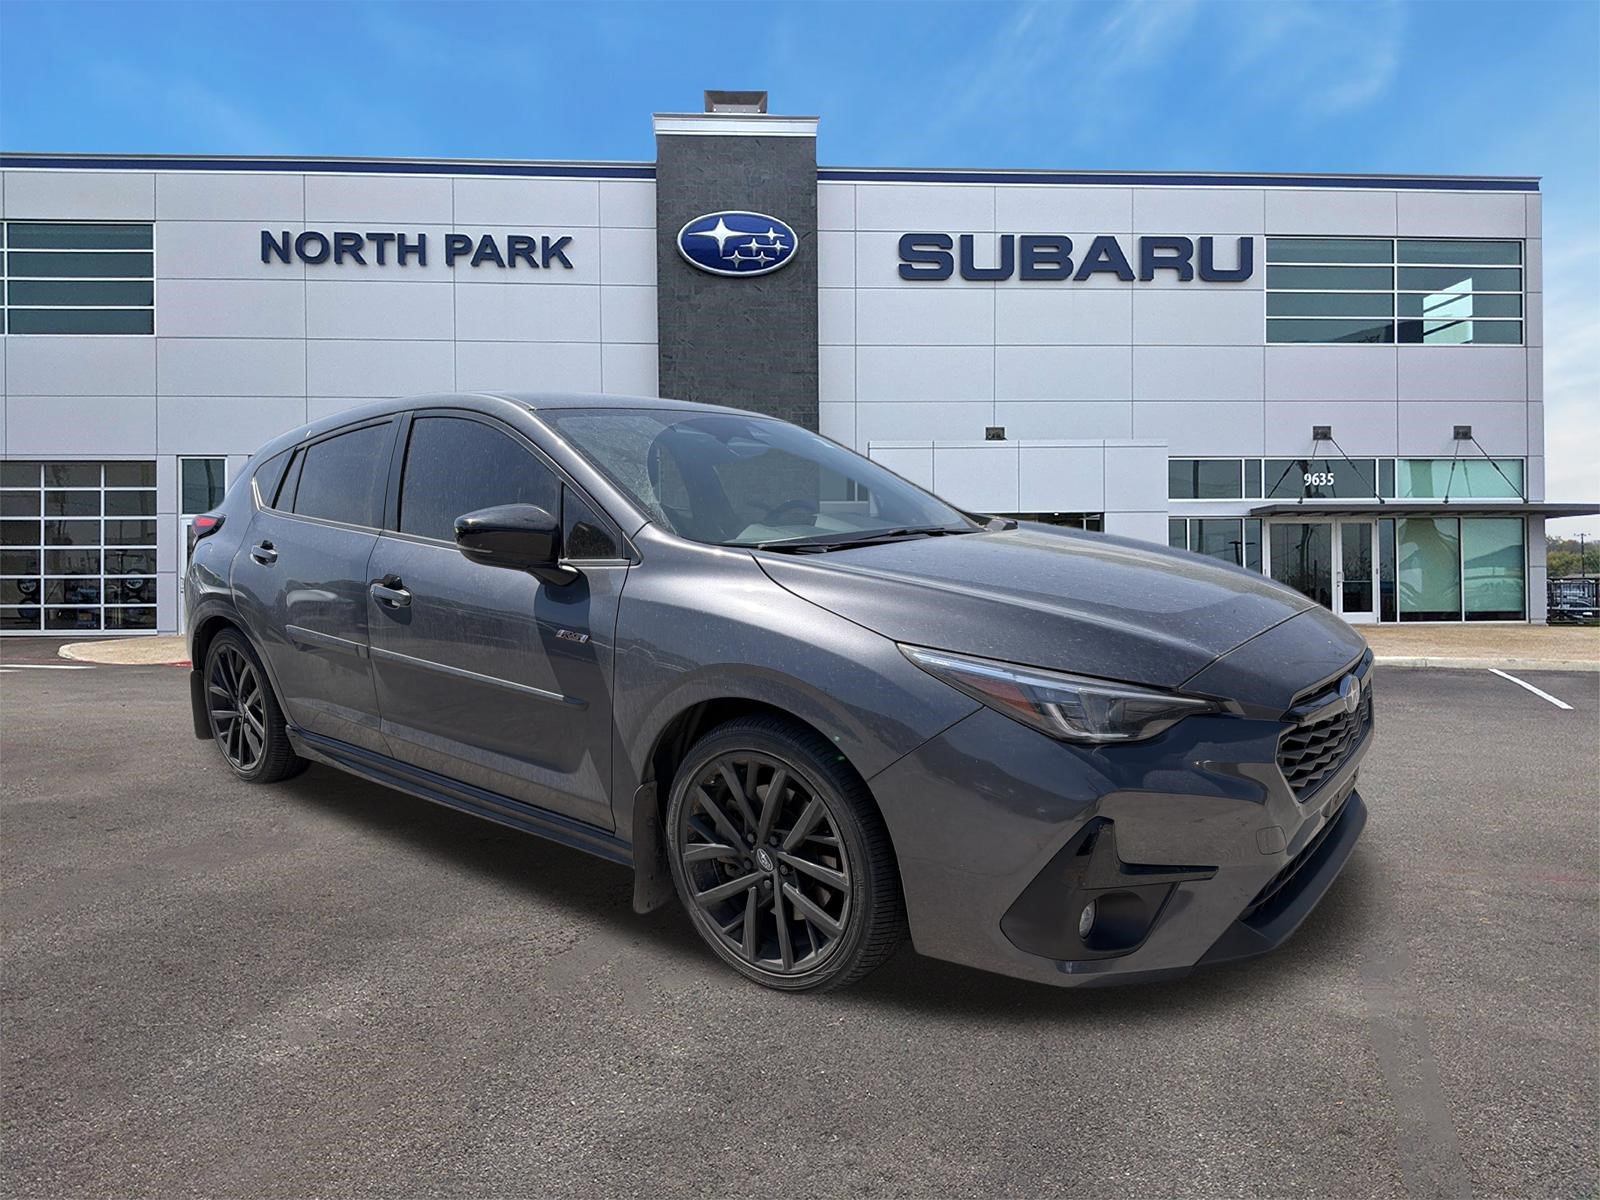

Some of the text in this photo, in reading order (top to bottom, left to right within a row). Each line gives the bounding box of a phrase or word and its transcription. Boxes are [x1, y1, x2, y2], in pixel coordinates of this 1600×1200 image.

[260, 230, 574, 269] NORTH PARK
[898, 233, 1254, 282] SUBARU
[1304, 473, 1334, 486] 9635
